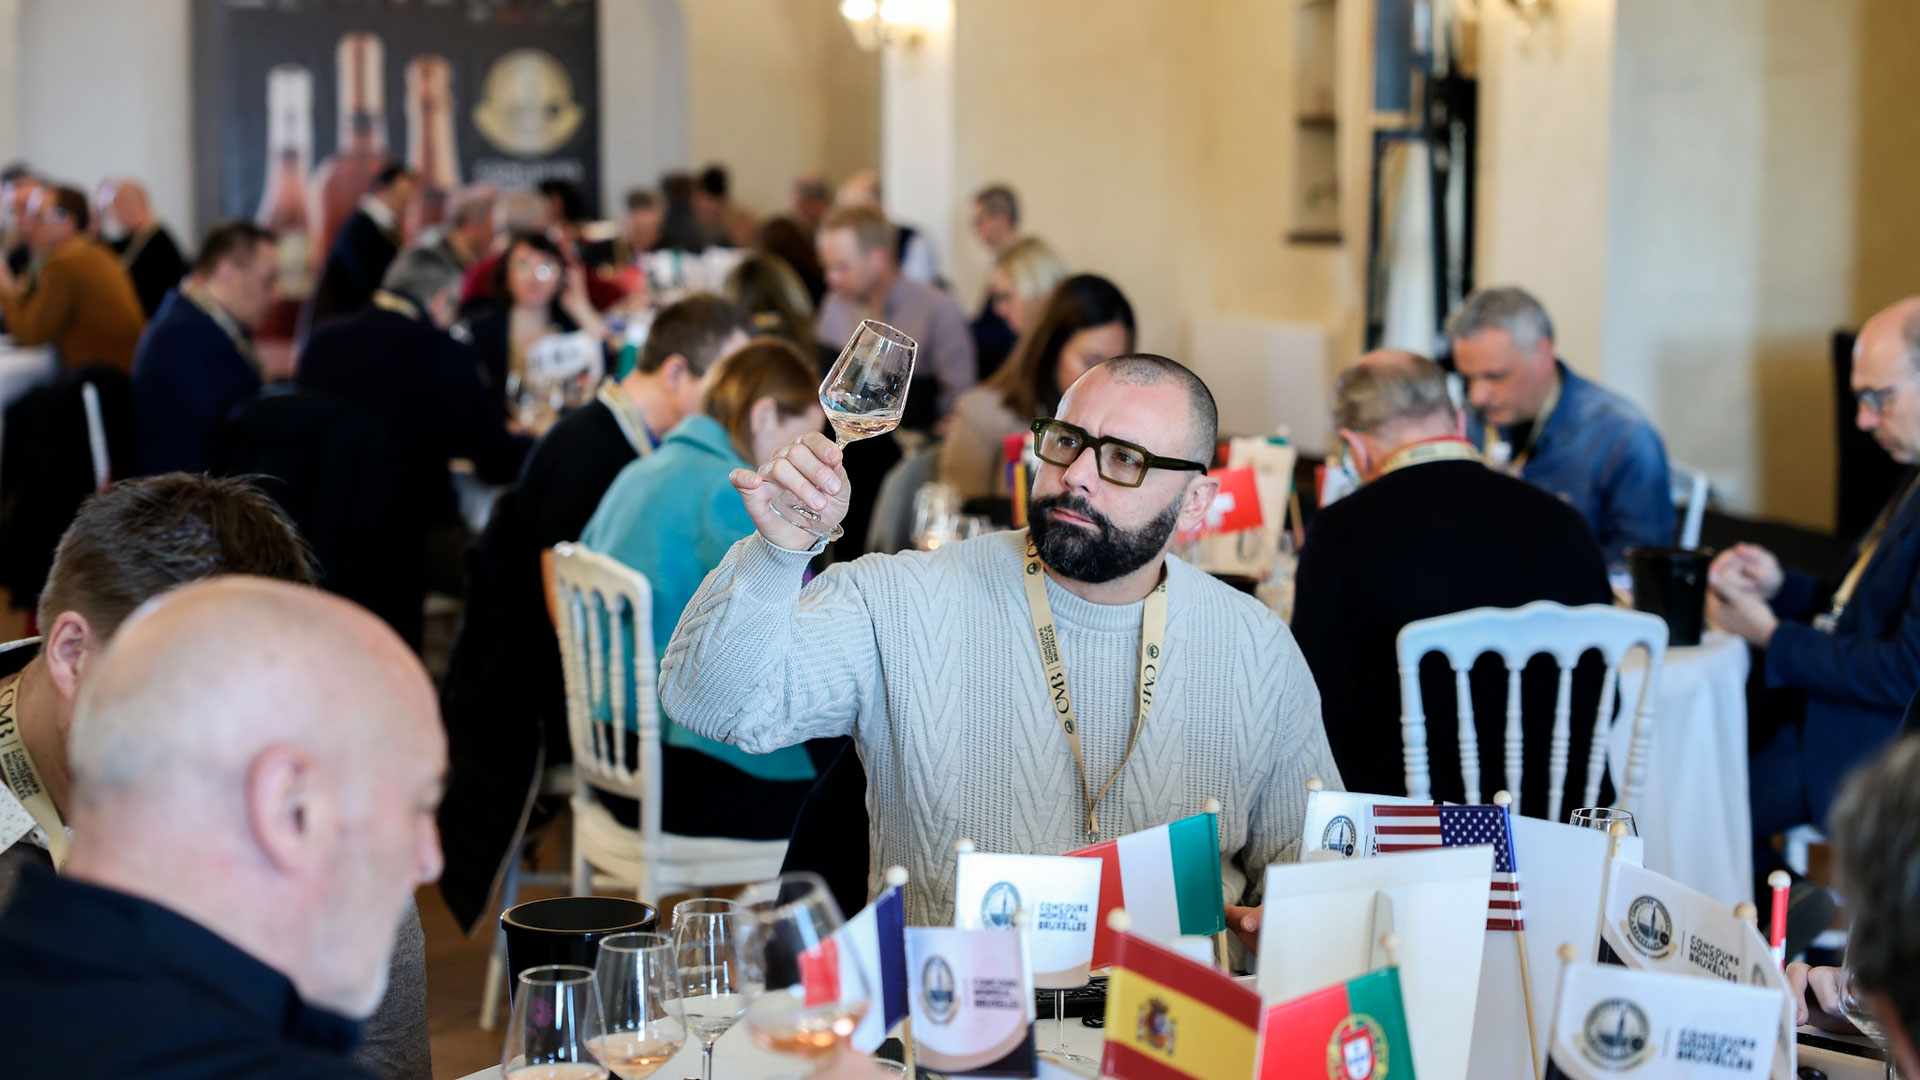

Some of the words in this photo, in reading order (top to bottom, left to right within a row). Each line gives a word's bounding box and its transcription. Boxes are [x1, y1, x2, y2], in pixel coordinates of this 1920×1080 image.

[1050, 672, 1070, 715] CMB
[1689, 934, 1740, 966] CONCOURS
[1689, 944, 1730, 970] MONDIAL
[1688, 953, 1738, 984] BRUXELLES
